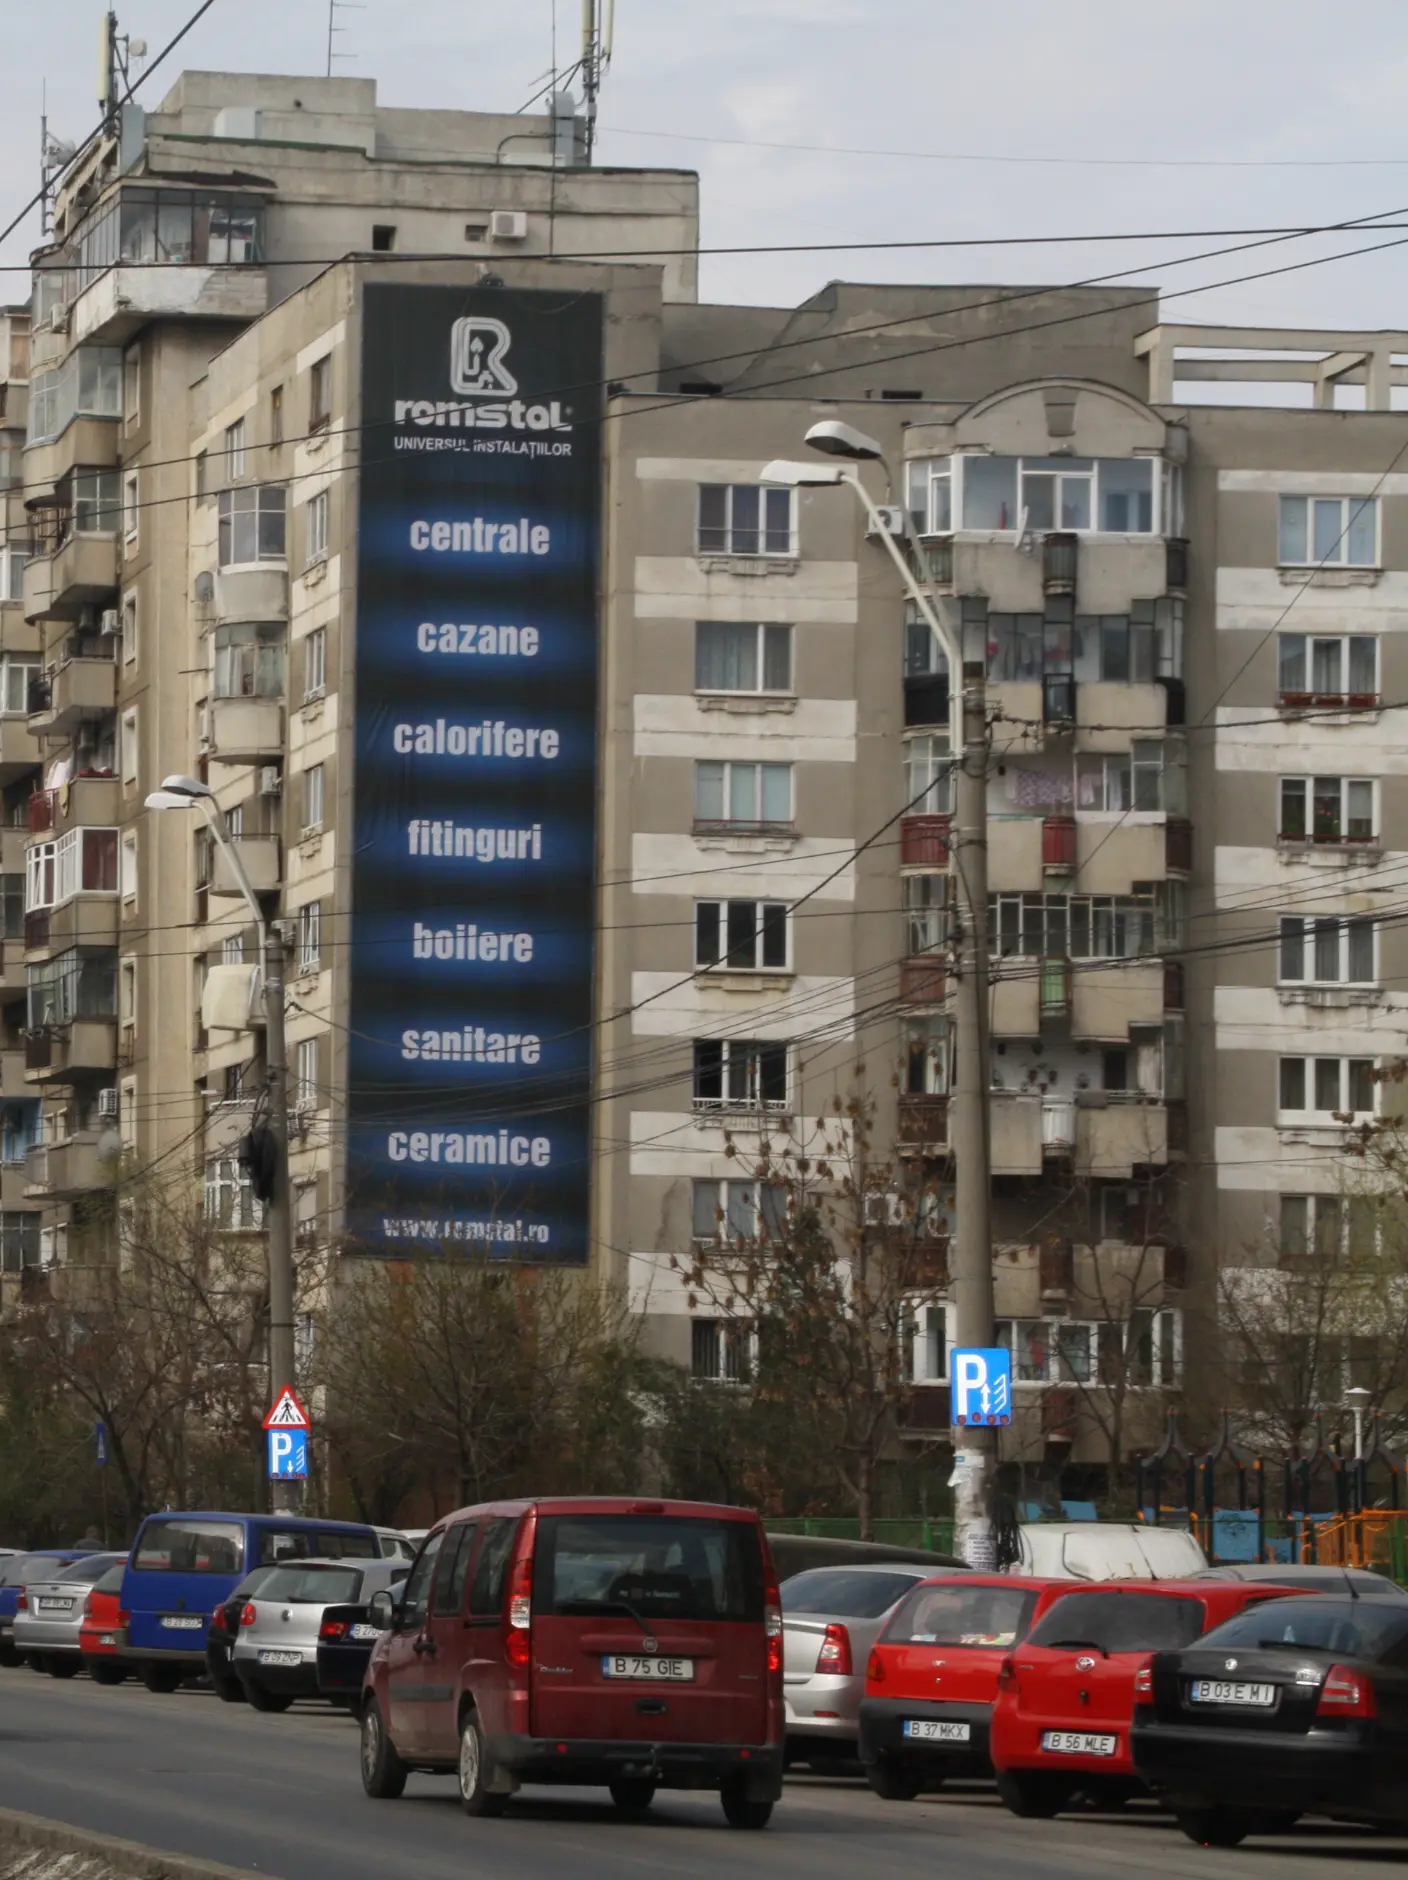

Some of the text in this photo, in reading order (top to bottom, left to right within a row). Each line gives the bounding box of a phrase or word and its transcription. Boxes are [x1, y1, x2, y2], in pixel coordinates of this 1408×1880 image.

[394, 437, 471, 451] UNIVERSUL
[410, 517, 550, 555] centrale
[417, 623, 539, 656] cazane
[394, 718, 559, 759] calorifere
[408, 820, 541, 863] fitinguri
[413, 922, 533, 963] boilere
[401, 1026, 541, 1064] sanitare
[388, 1129, 550, 1166] ceramice
[956, 1354, 987, 1416] P
[272, 1432, 292, 1473] P
[615, 1658, 684, 1676] B 75 GIE
[1200, 1682, 1210, 1697] B
[1214, 1683, 1231, 1698] 03
[912, 1722, 964, 1738] B 37 MKX
[1051, 1734, 1109, 1751] B 56 MLE
